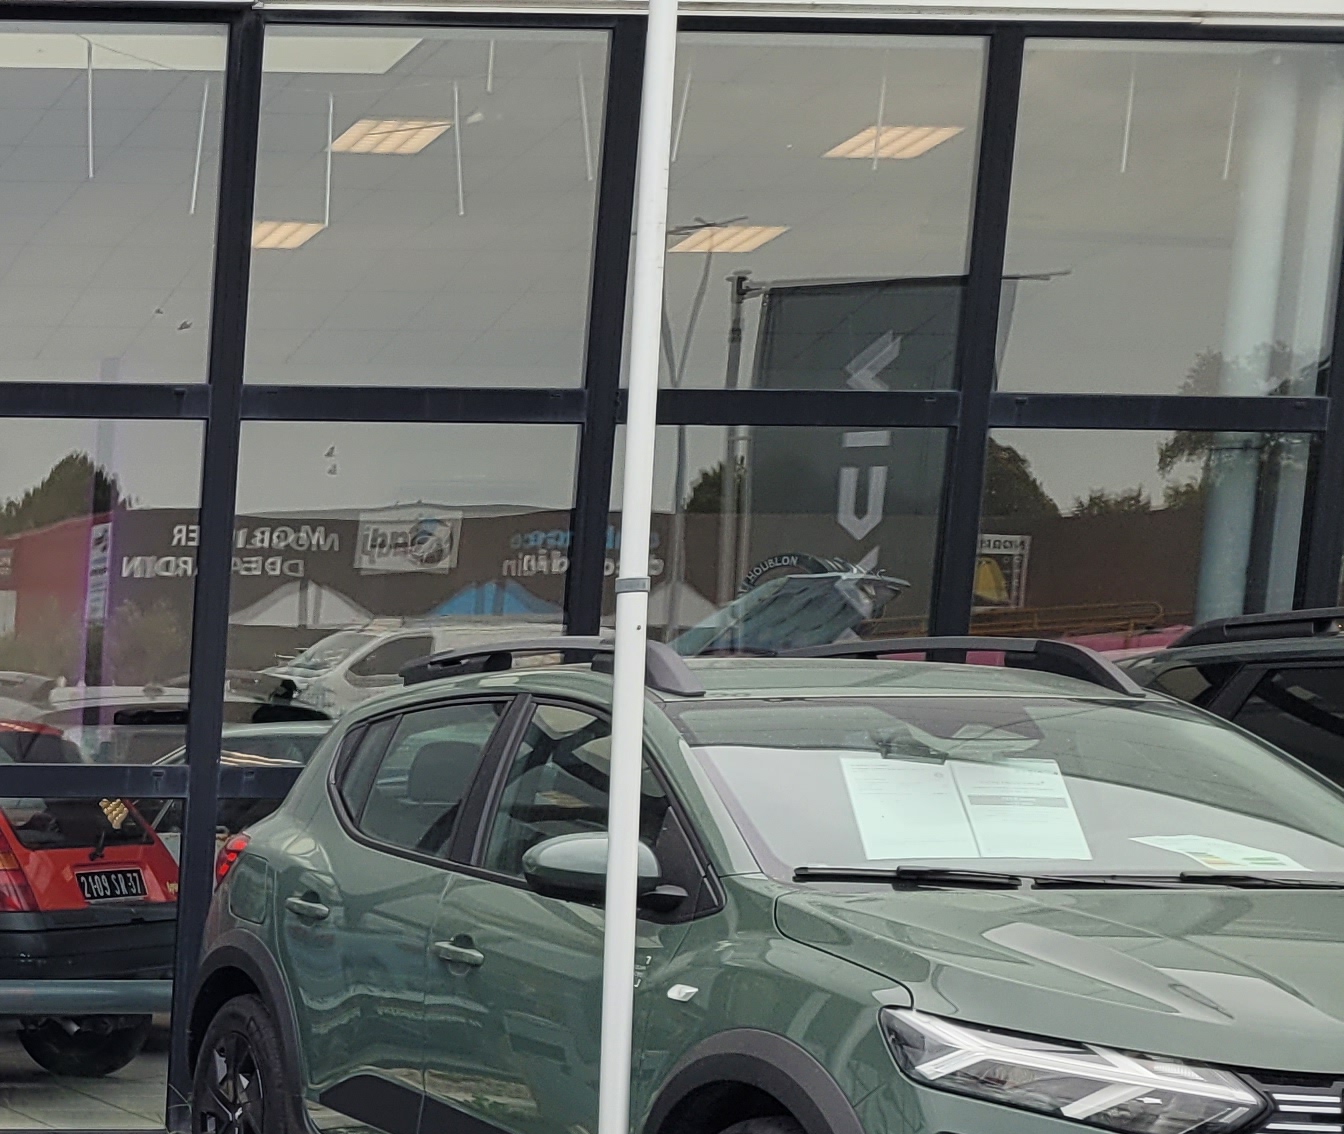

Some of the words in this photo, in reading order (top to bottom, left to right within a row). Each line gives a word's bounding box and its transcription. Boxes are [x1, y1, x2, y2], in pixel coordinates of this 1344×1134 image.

[746, 555, 798, 583] HOUBLON
[81, 874, 111, 898] 2109
[111, 873, 129, 896] SR
[127, 872, 141, 894] 37
